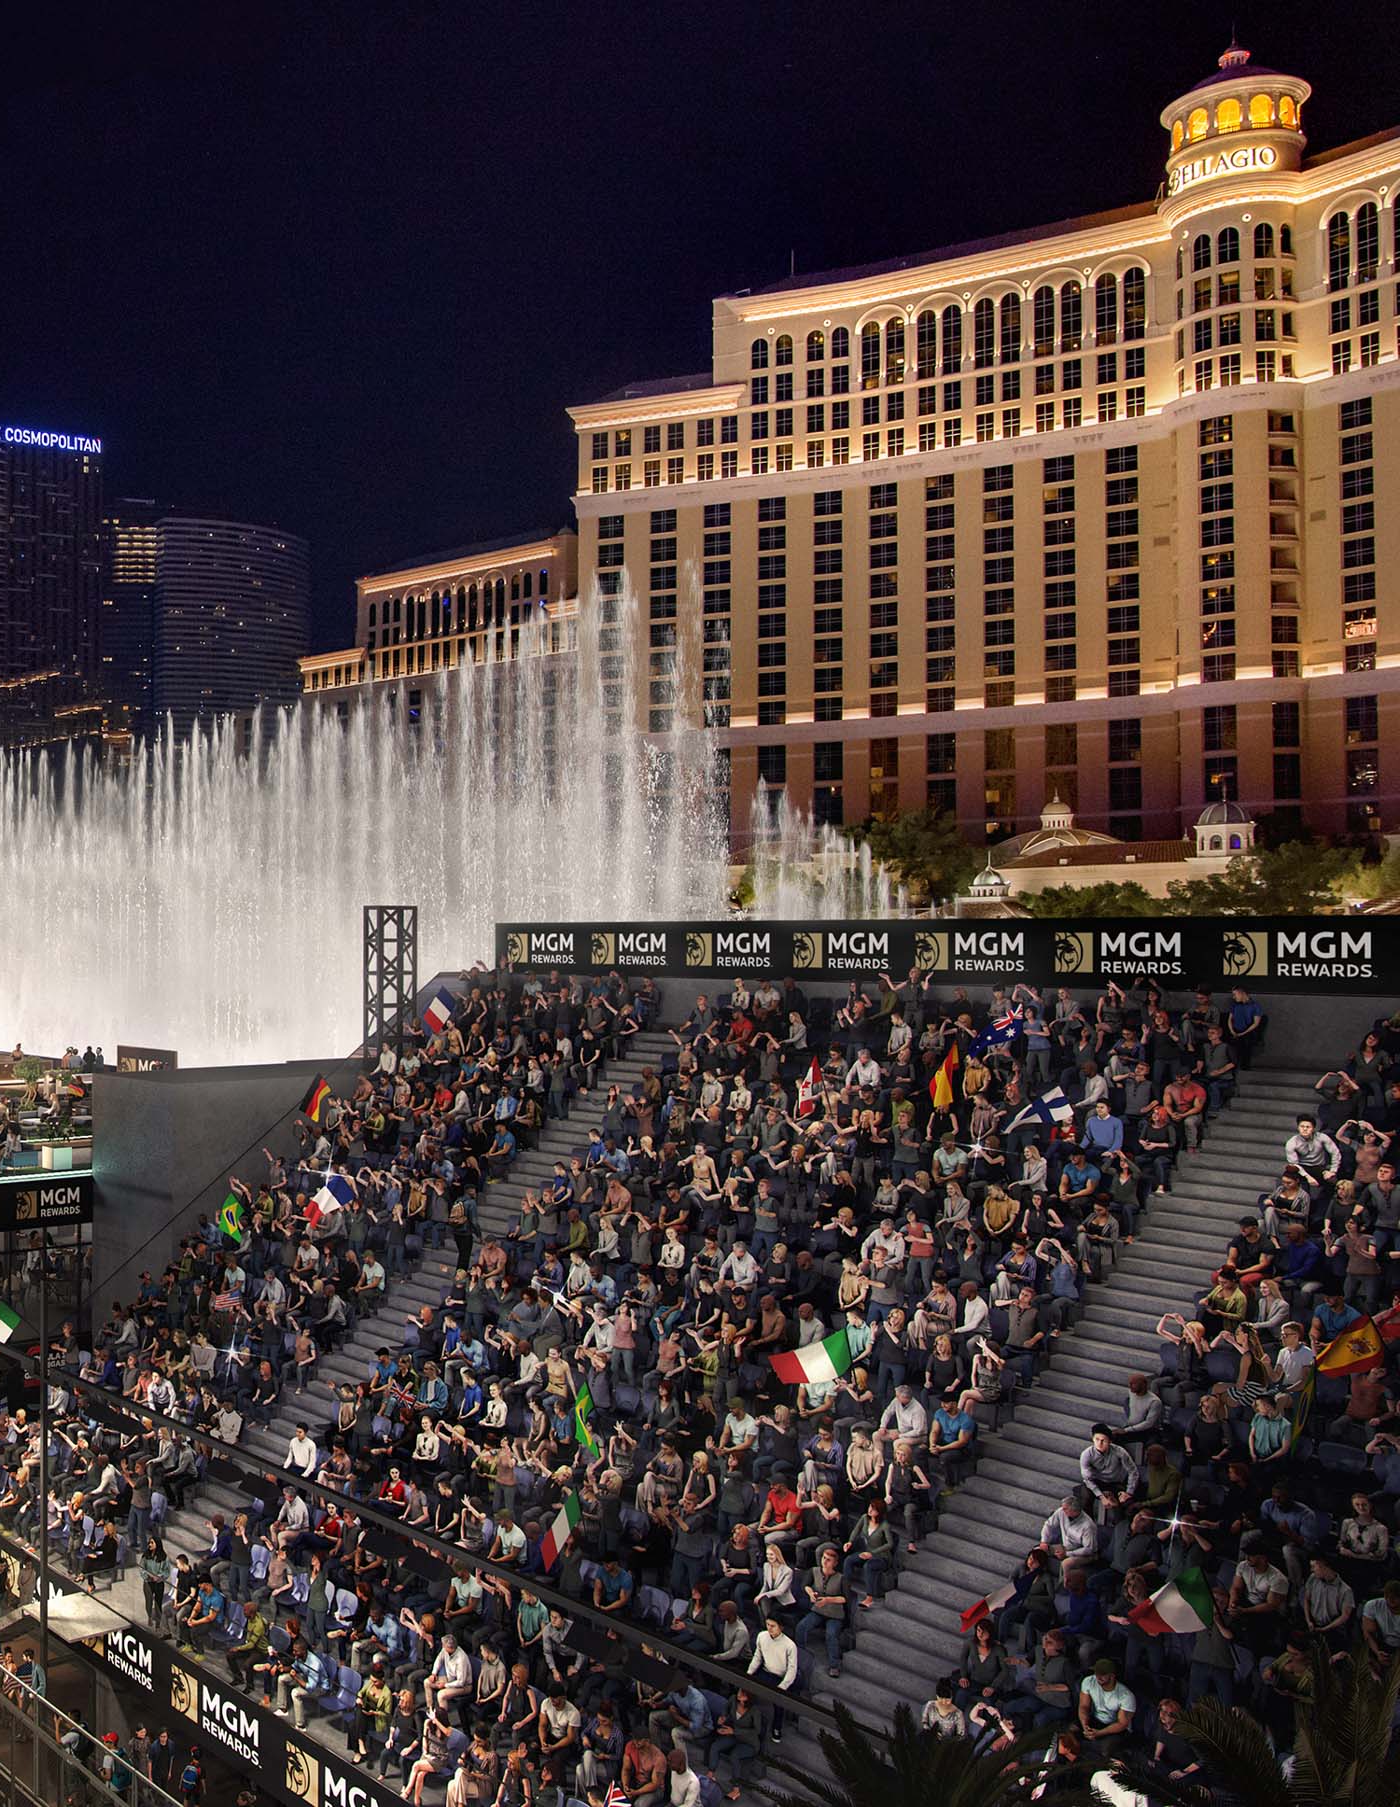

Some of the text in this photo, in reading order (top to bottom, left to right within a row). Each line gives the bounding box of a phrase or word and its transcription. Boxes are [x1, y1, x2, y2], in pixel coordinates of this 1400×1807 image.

[1168, 147, 1276, 194] BELLAGIO
[5, 427, 101, 453] COSMOPOLITAN
[532, 933, 574, 951] MGM
[619, 933, 666, 953] MGM
[717, 933, 770, 954] MGM
[828, 933, 888, 955] MGM
[954, 932, 1024, 956] MGM
[1101, 932, 1181, 958] MGM
[1277, 932, 1372, 960] MGM
[532, 955, 574, 964] REWARDS
[619, 956, 666, 966] REWARDS
[716, 956, 770, 968] REWARDS
[828, 957, 889, 970] REWARDS
[954, 958, 1024, 972] REWARDS
[1100, 961, 1182, 975] REWARDS
[1277, 962, 1373, 978] REWARDS
[40, 1186, 80, 1206] MGM
[40, 1206, 80, 1217] REWARDS
[108, 1630, 152, 1674] MGM
[108, 1650, 152, 1690] REWARDS
[202, 1685, 259, 1748] MGM
[202, 1716, 260, 1766] REWARDS
